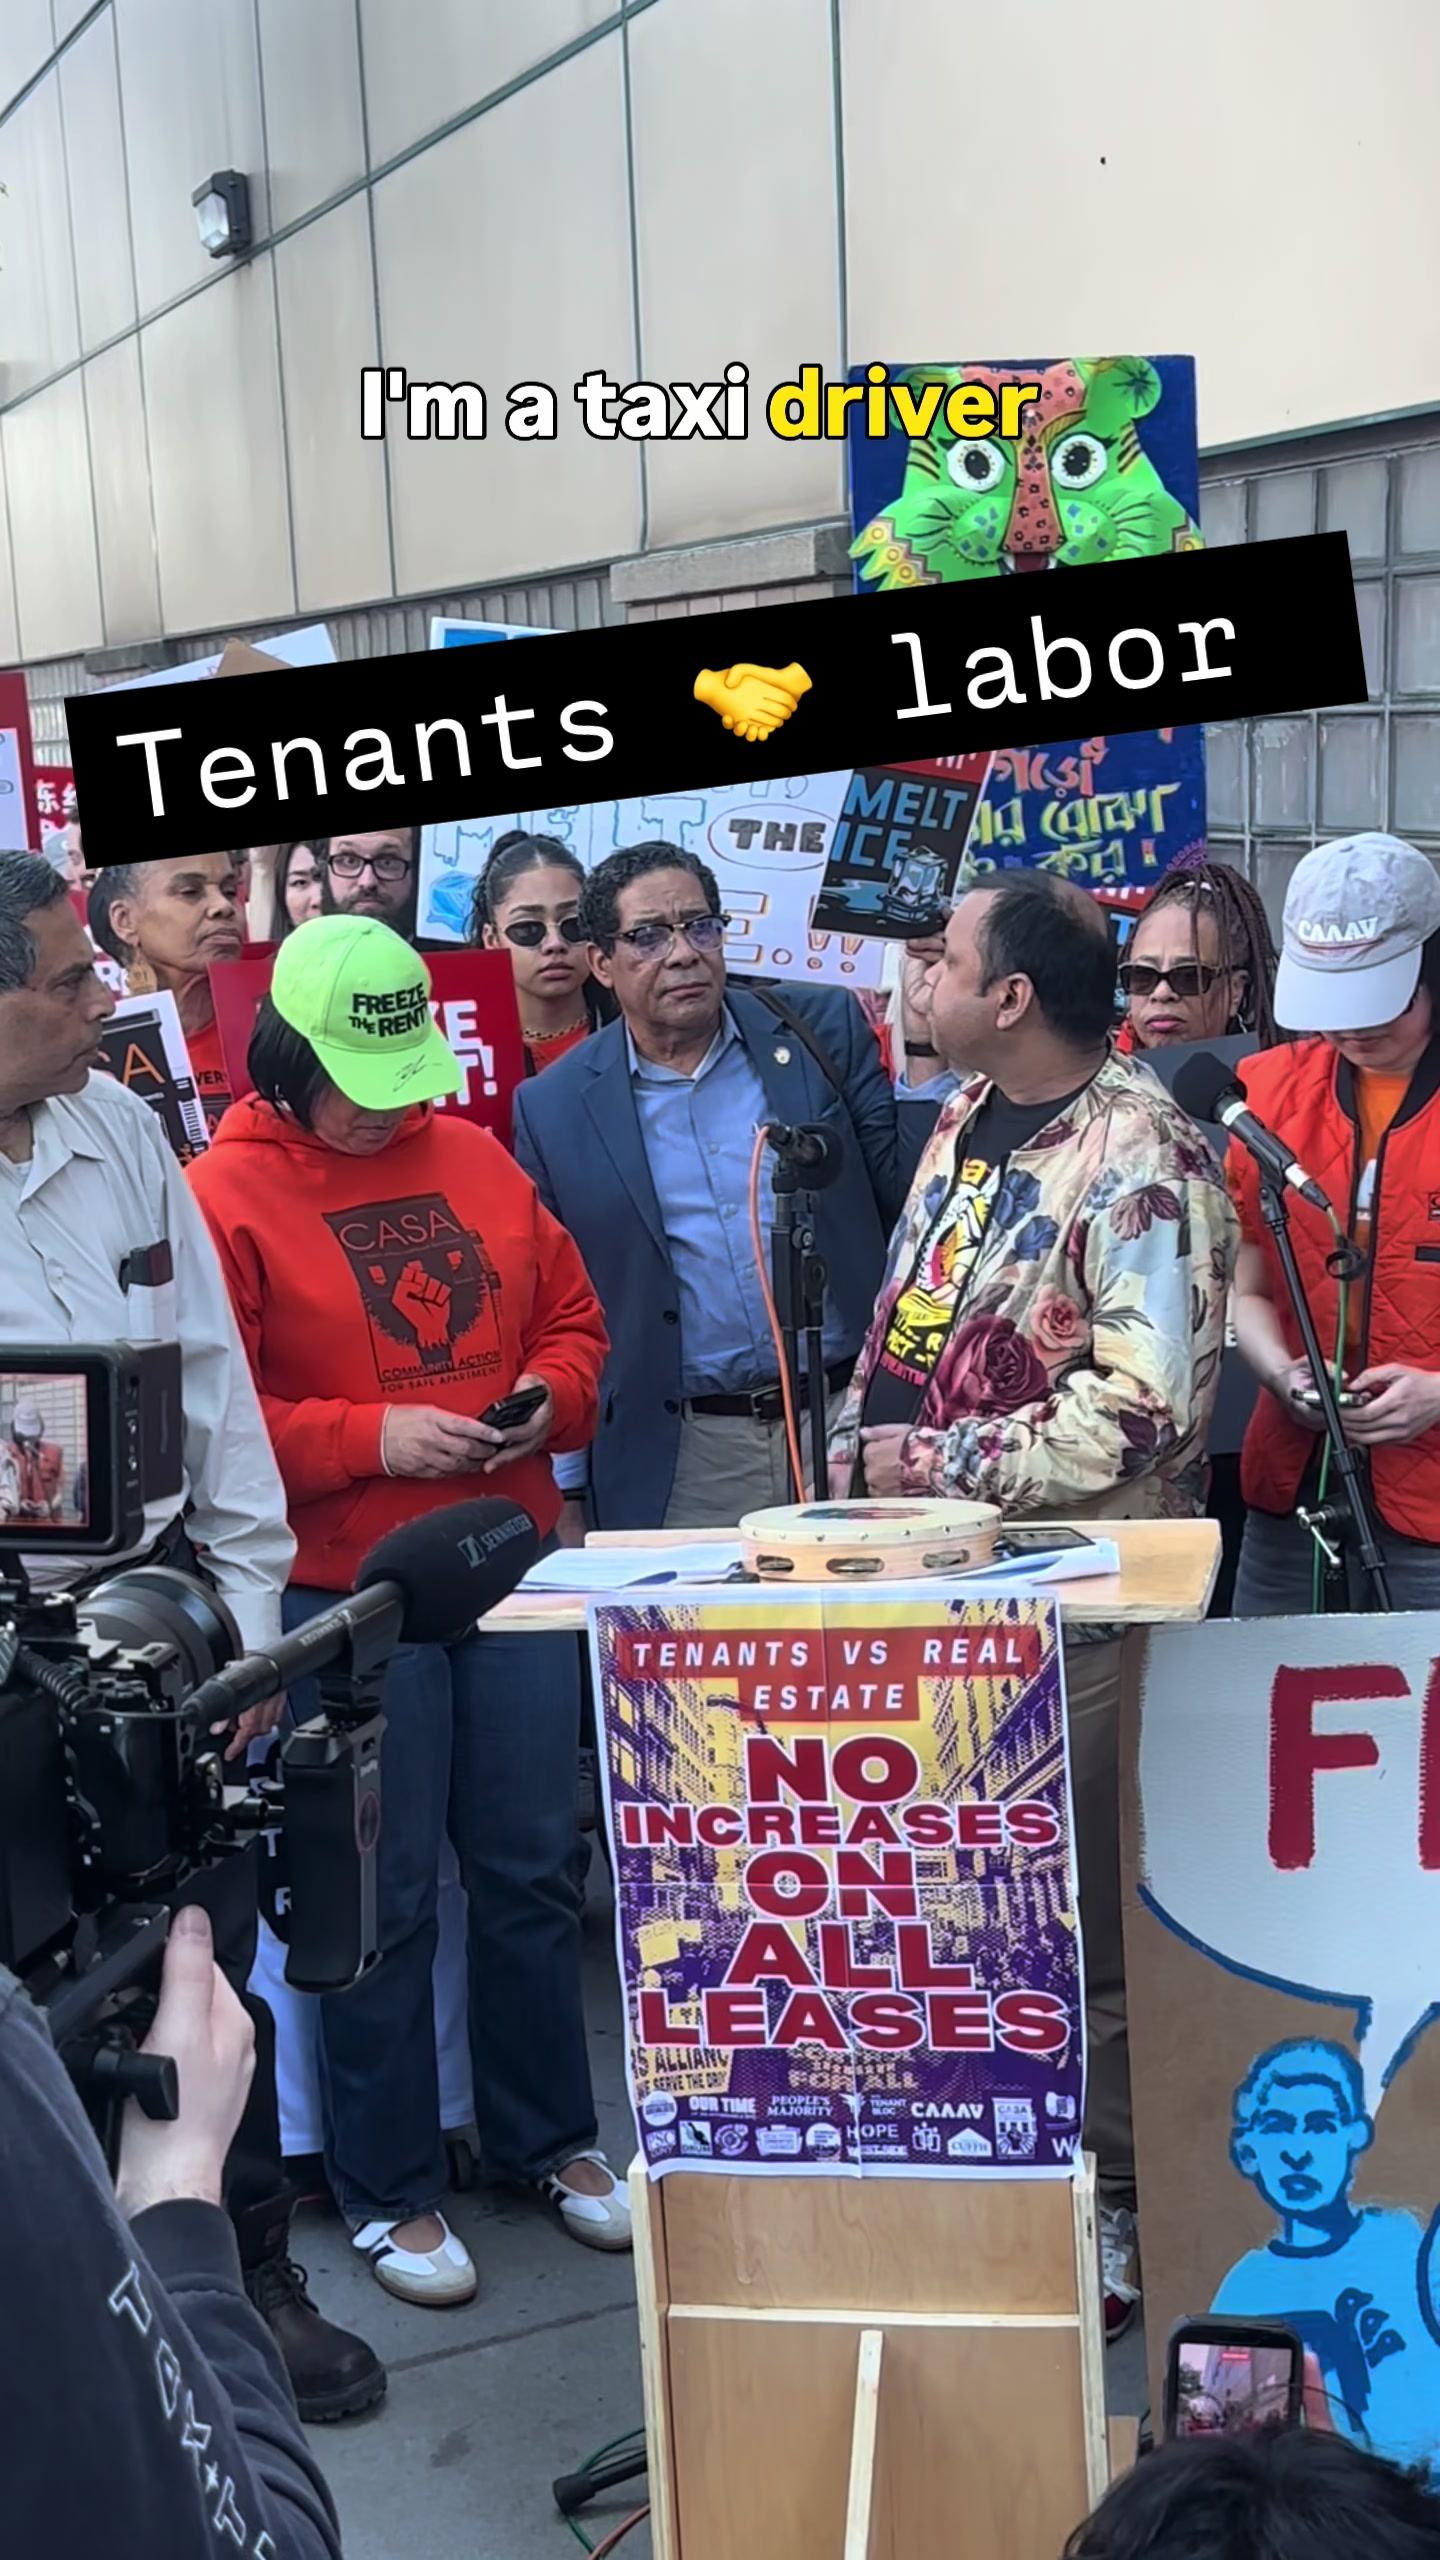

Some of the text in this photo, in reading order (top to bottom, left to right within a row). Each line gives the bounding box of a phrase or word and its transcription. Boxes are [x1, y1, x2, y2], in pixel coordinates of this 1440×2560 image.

[843, 774, 969, 830] MELT
[729, 819, 826, 854] THE
[831, 821, 914, 871] ICE
[352, 982, 427, 1015] FREEZE
[349, 1003, 428, 1038] THE RENT
[339, 1210, 461, 1251] CASA
[382, 1350, 502, 1381] COMMUNITY ACTION
[381, 1383, 405, 1394] FOR
[410, 1378, 435, 1391] SAFE
[633, 1636, 1025, 1669] TENANTS VS REAL
[753, 1682, 906, 1713] ESTATE
[743, 1733, 920, 1805] NO
[620, 1800, 1059, 1849] INCREASES
[743, 1848, 919, 1920] ON
[722, 1918, 975, 1991] ALL
[635, 1987, 1071, 2053] LEASES
[689, 2095, 719, 2113] OUR
[720, 2097, 757, 2115] TIME
[767, 2105, 834, 2117] MAJORITY
[772, 2094, 831, 2106] PEOPLE'S
[846, 2123, 900, 2139] HOPE
